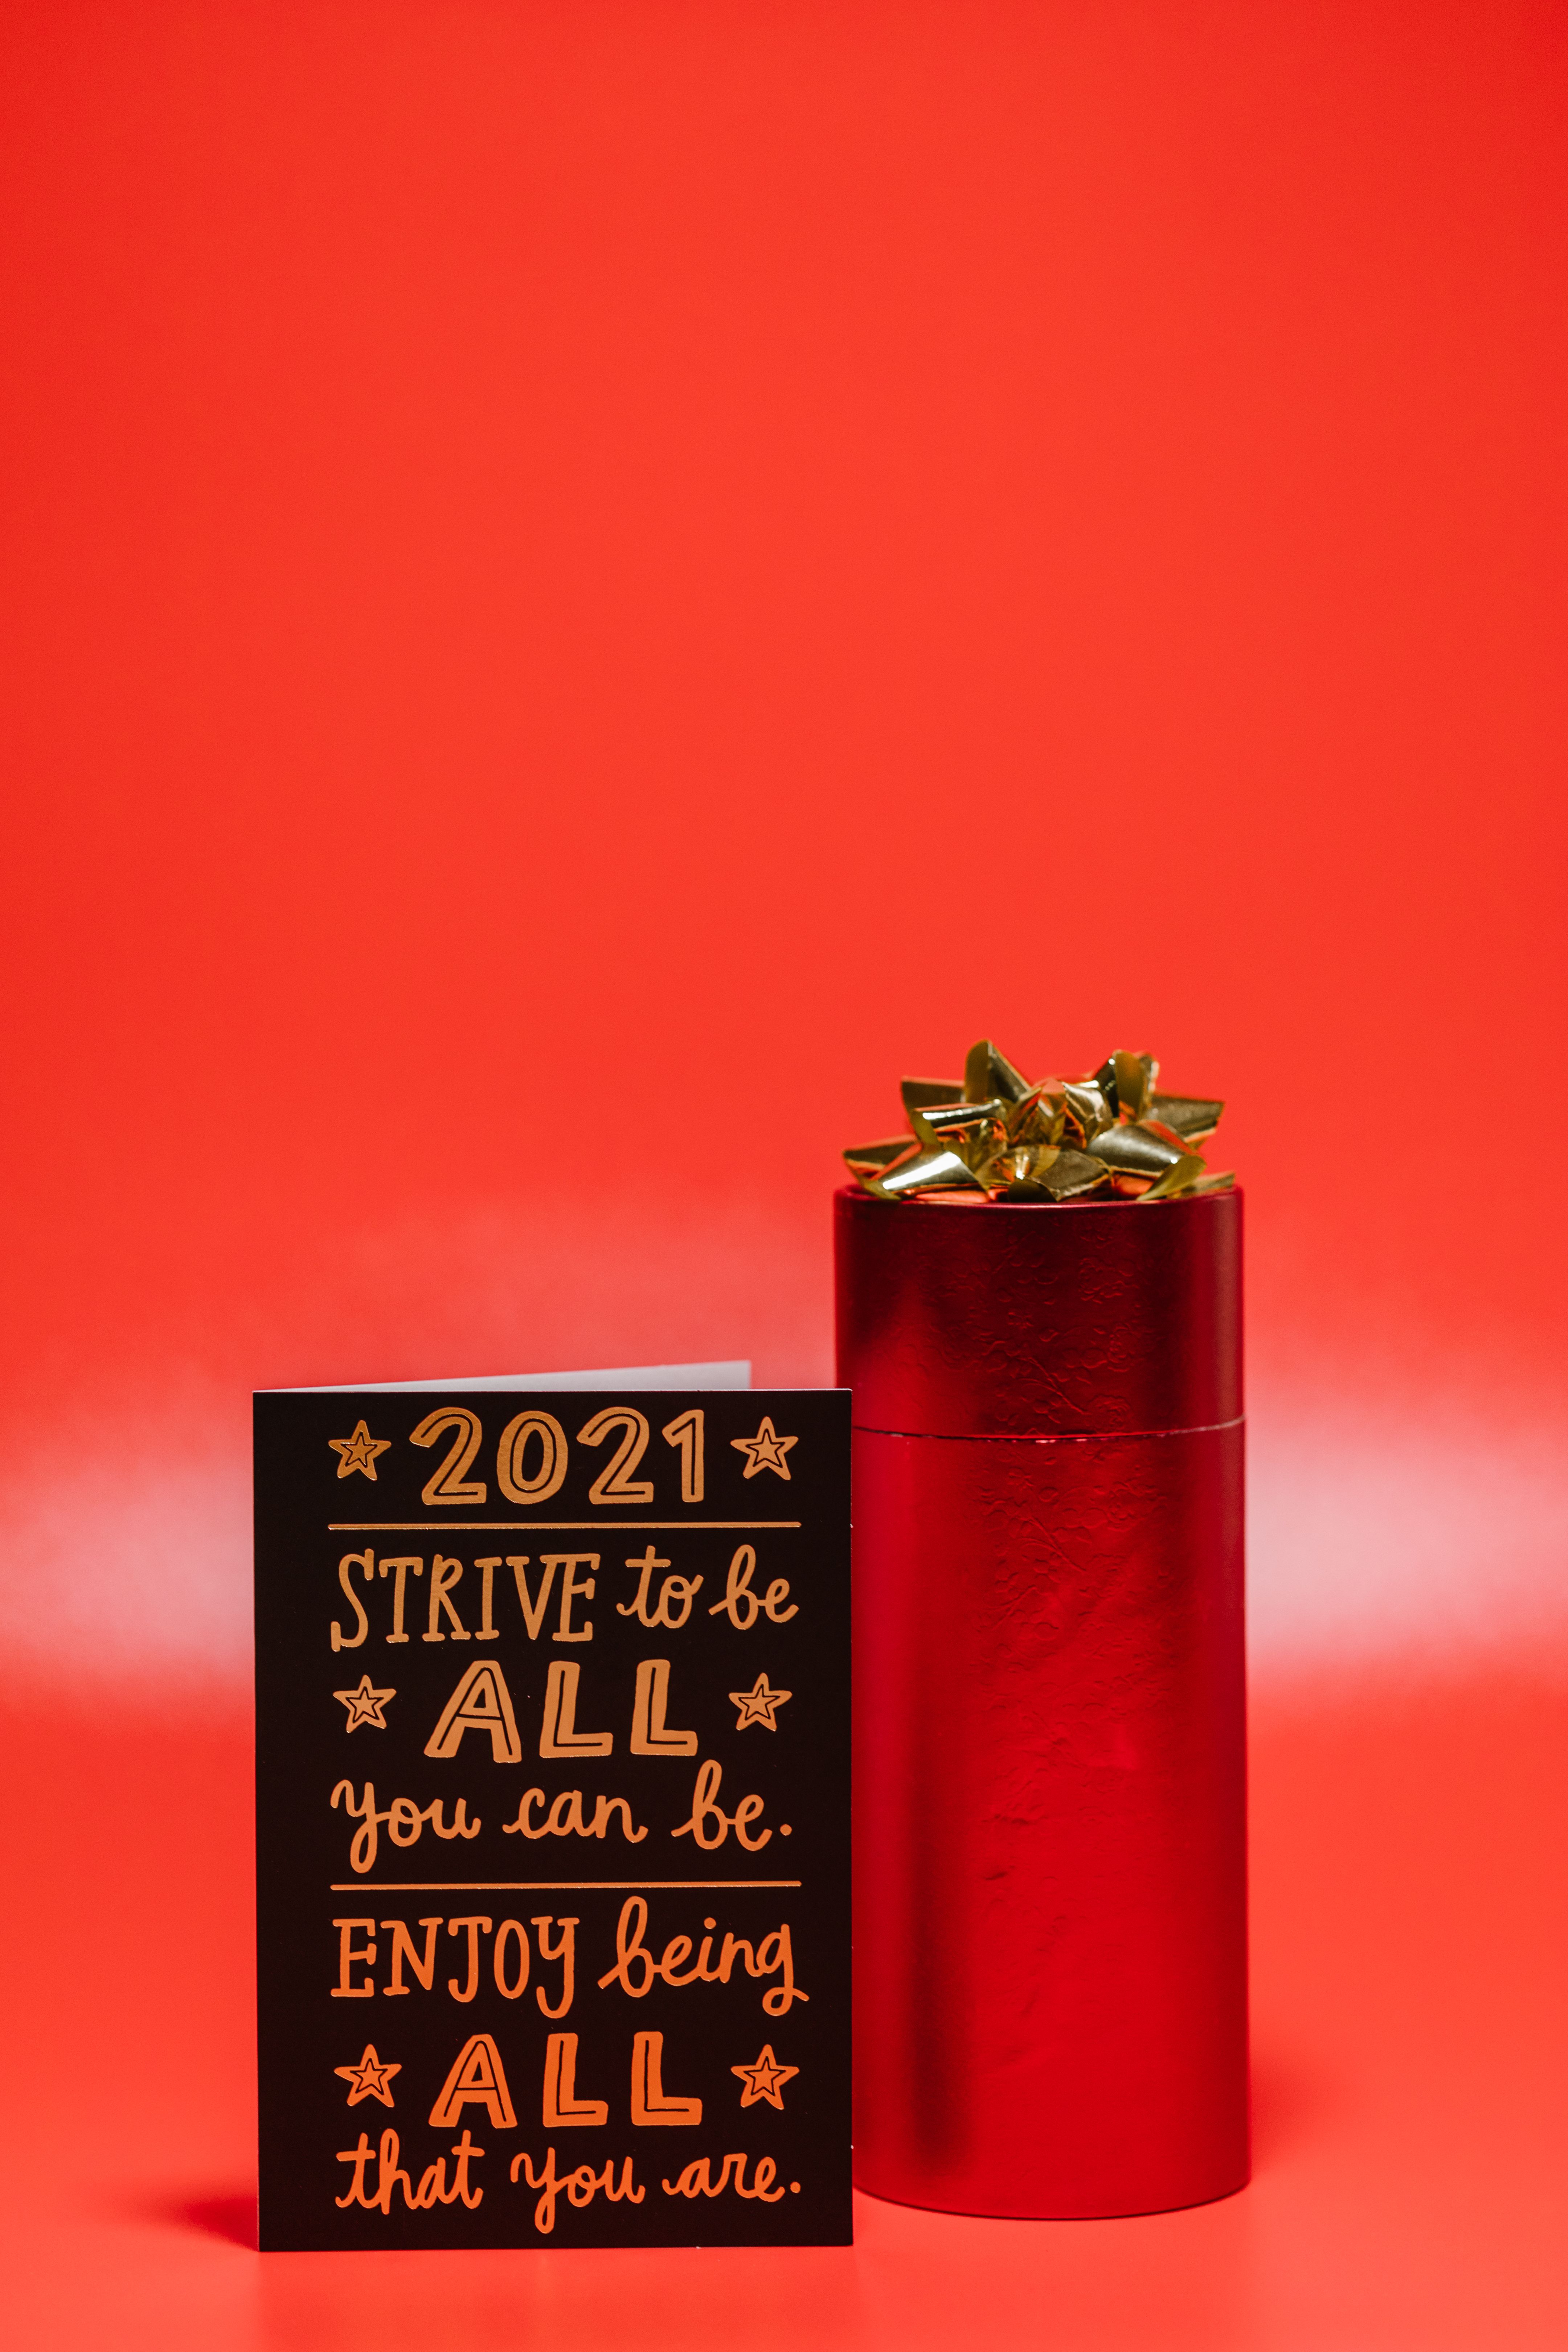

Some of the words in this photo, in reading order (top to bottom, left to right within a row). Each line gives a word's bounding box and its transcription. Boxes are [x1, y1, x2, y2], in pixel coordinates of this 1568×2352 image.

[409, 1406, 705, 1506] 2021
[330, 1548, 601, 1652] STRIVE
[615, 1545, 704, 1629] to
[708, 1544, 799, 1631] be
[423, 1658, 699, 1764] ALL
[329, 1779, 482, 1874] you
[501, 1787, 649, 1844] can
[670, 1759, 793, 1852] be.
[330, 1915, 580, 2019] ENJOY
[597, 1895, 810, 2017] being
[427, 2030, 703, 2130] ALL
[335, 2128, 486, 2216] that
[509, 2147, 646, 2234] you
[661, 2152, 801, 2203] are.
